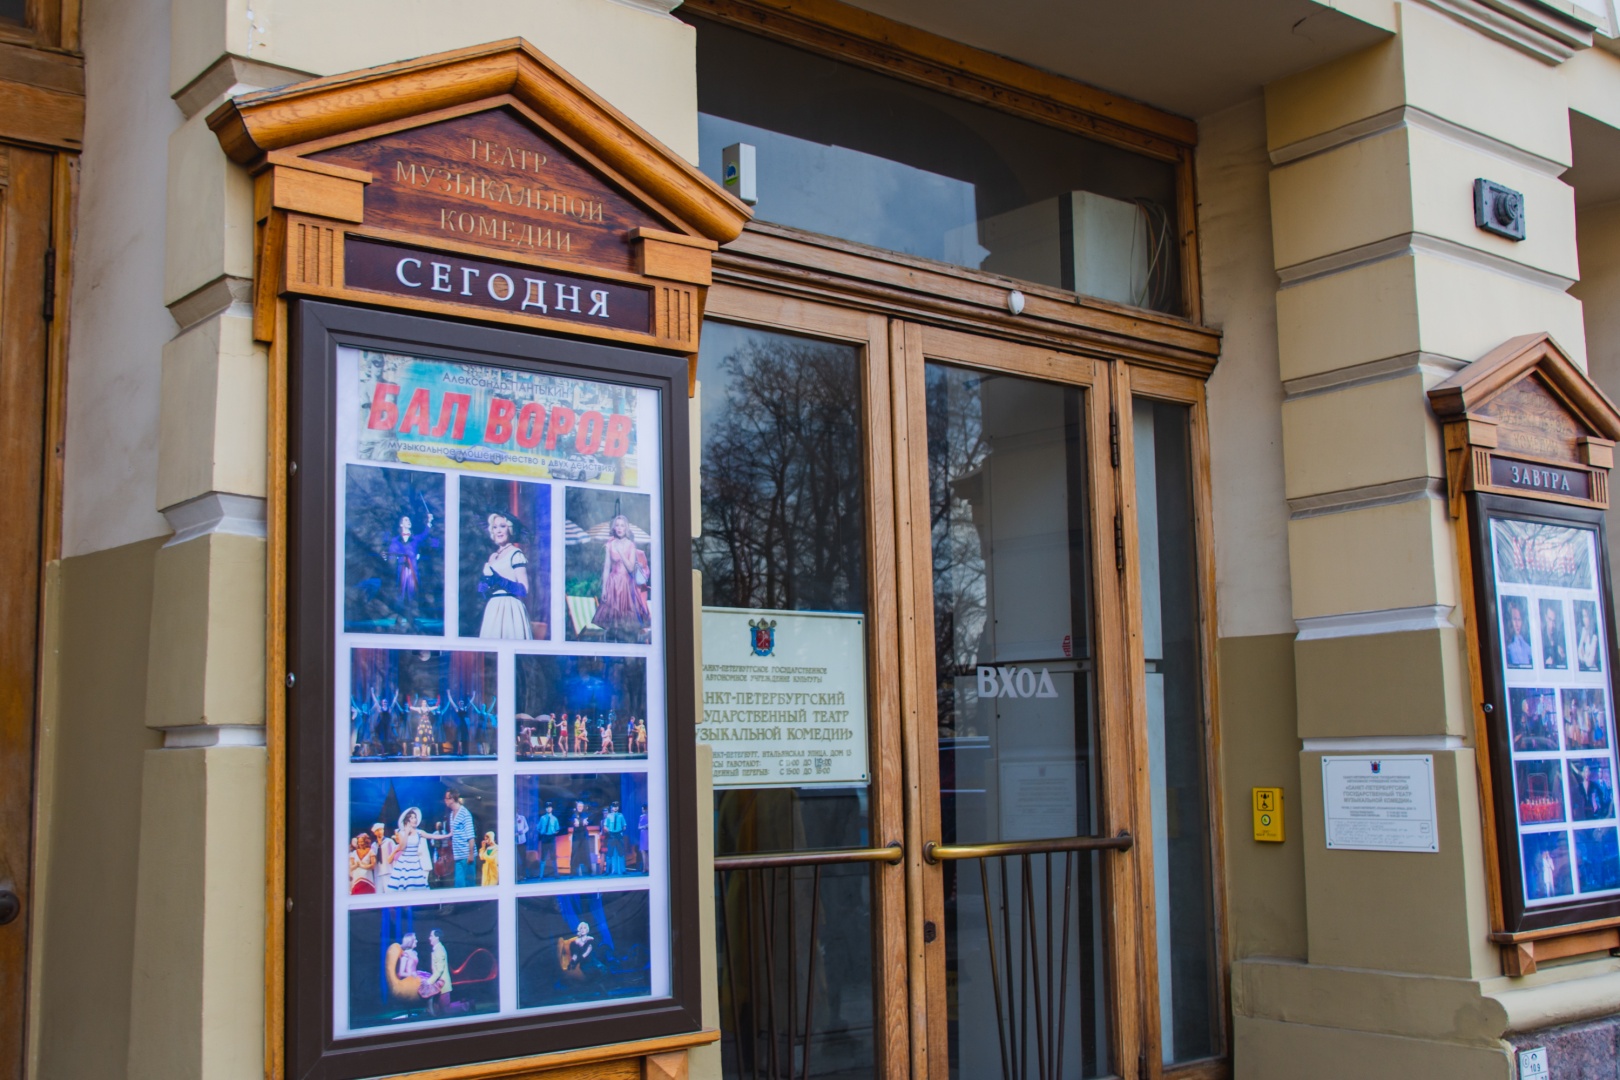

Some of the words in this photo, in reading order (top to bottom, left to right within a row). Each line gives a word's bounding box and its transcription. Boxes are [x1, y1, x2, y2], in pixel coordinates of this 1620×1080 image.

[467, 137, 547, 173] ТЕАТР
[396, 160, 604, 222] МУЗЫКАЛЬНОЙ
[440, 207, 571, 252] КОМЕДИИ
[396, 257, 610, 318] СЕГОДНЯ
[443, 372, 508, 391] Александр
[512, 381, 570, 398] ПАНТЫКИН
[367, 381, 472, 441] БАЛ
[483, 397, 633, 458] ВОРОВ
[388, 441, 458, 456] музыкальное
[1511, 465, 1570, 491] ЗАВТРА
[976, 665, 1059, 699] ВХОД
[703, 690, 845, 705] НКТ-ПЕТЕРБУРГСКИЙ
[703, 709, 807, 724] УДАРСТВЕННЫЙ
[812, 710, 850, 723] ТЕАТР
[787, 727, 854, 742] КОМЕДИИ»
[712, 760, 724, 768] СЫ
